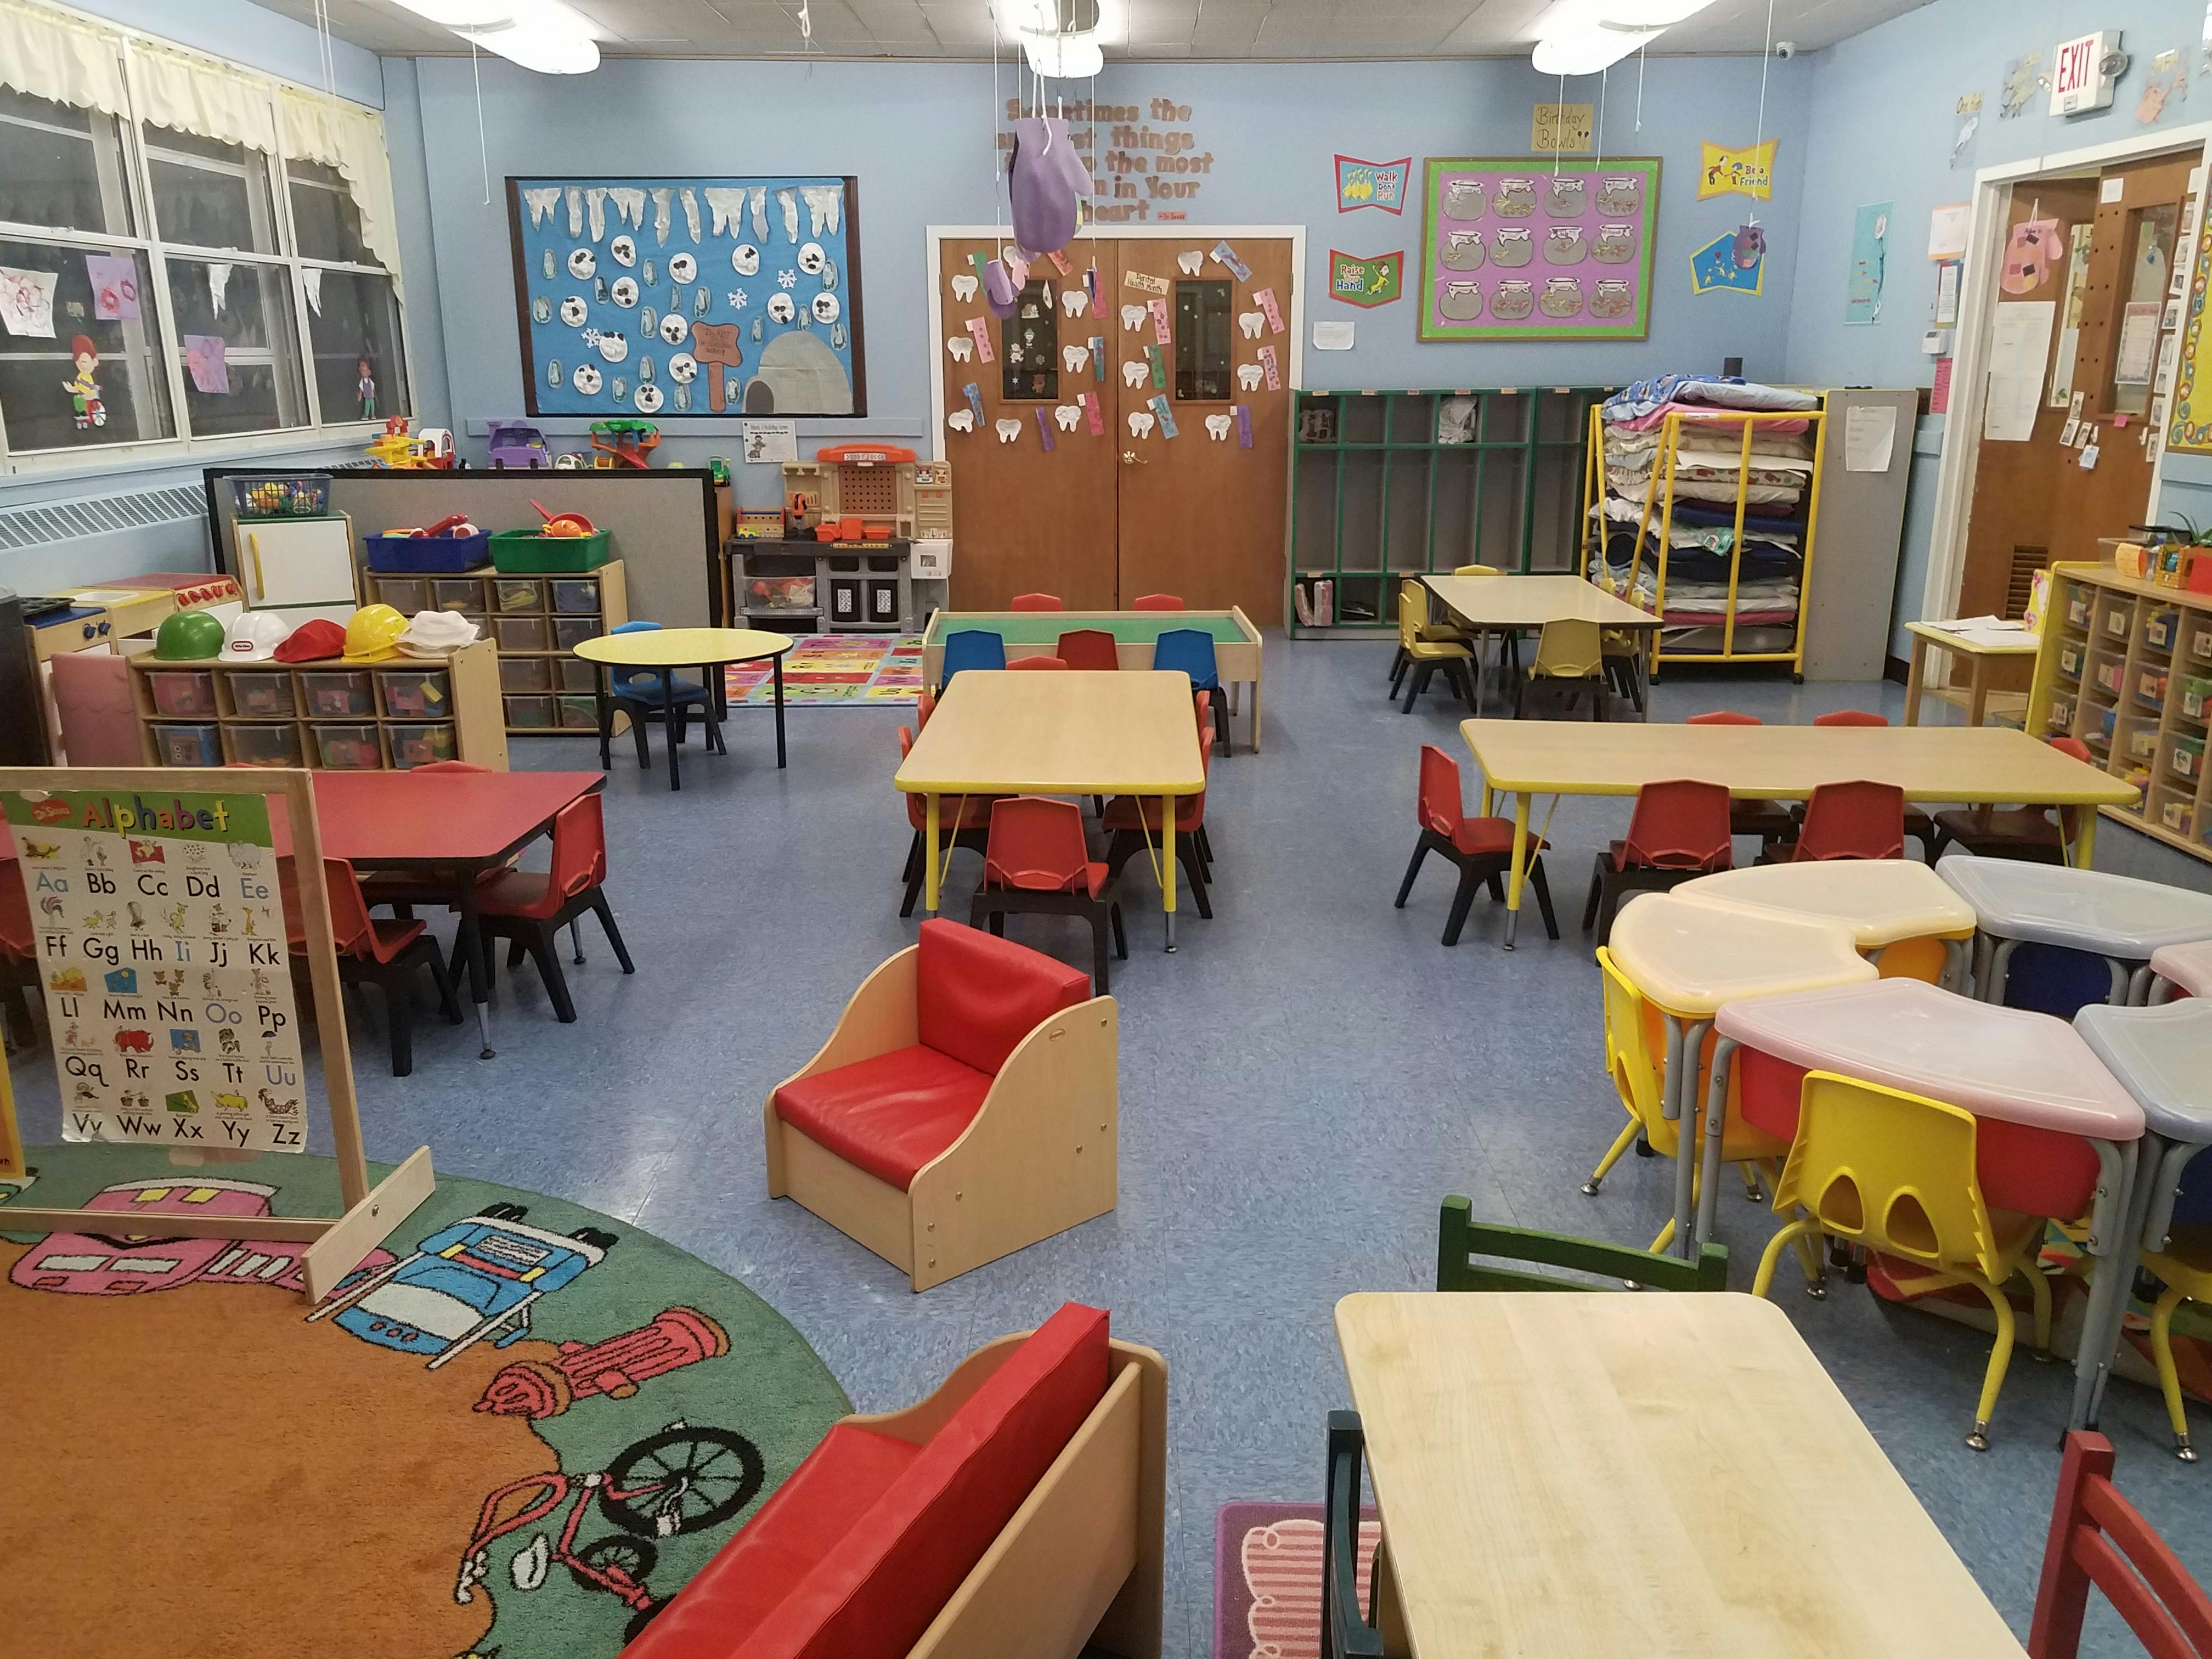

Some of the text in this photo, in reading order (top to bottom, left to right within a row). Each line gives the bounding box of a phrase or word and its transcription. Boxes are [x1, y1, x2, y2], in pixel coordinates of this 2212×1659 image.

[2058, 40, 2094, 93] EXIT
[1006, 97, 1192, 122] Sometimes the
[1111, 125, 1195, 155] things
[1537, 128, 1575, 149] Bowls
[1105, 151, 1147, 173] the
[1155, 152, 1214, 173] most
[1746, 166, 1756, 174] Be
[1114, 175, 1201, 199] in Your
[1375, 171, 1398, 182] Walk
[1378, 192, 1395, 200] Run
[1082, 199, 1149, 222] heart
[1136, 273, 1156, 285] Dental
[1341, 265, 1364, 274] Raise
[1128, 278, 1163, 294] Health Month
[1337, 279, 1363, 291] Hand
[83, 794, 229, 839] Alphabet
[36, 872, 269, 899] Aa Bb Cc Dd Ee
[45, 935, 281, 967] Ff Gg Hh Ii Jj Kk
[61, 997, 286, 1032] Ll Mm Nn Oo Pp
[65, 1056, 296, 1087] Qq Rr Ss Tt Uu
[72, 1113, 301, 1148] Vv Ww Xx Yy Zz
